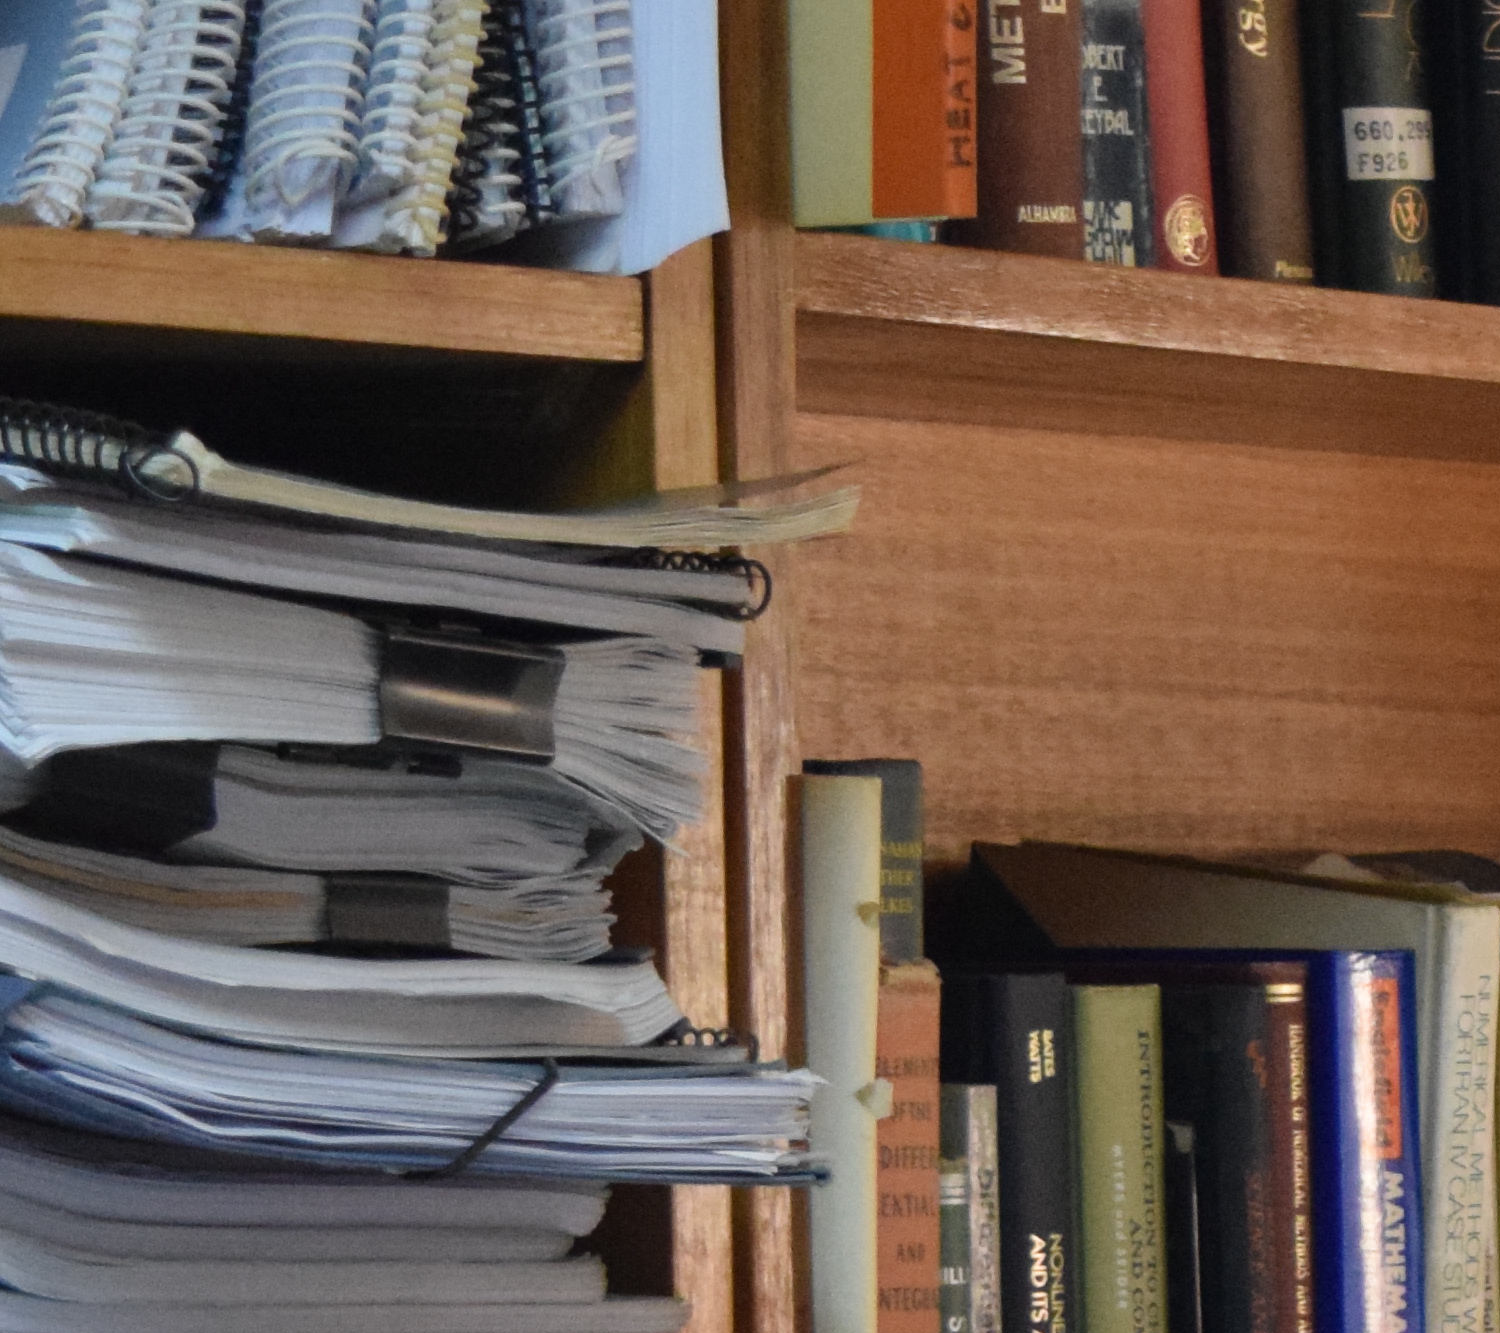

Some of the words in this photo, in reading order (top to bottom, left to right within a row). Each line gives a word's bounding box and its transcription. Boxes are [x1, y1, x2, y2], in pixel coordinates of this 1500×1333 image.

[1357, 150, 1409, 174] F926
[1028, 1029, 1044, 1083] WATTS
[1452, 994, 1475, 1134] FORTRAN
[1469, 974, 1492, 1135] NUMERICAL
[1137, 1029, 1158, 1248] INTRODUCTION
[1449, 1144, 1469, 1170] IV
[1444, 1175, 1465, 1254] CASE
[1463, 1151, 1488, 1299] METHODS
[1029, 1233, 1048, 1287] AND
[1130, 1218, 1144, 1280] AND
[1145, 1259, 1159, 1295] TO
[1031, 1290, 1050, 1322] ITS
